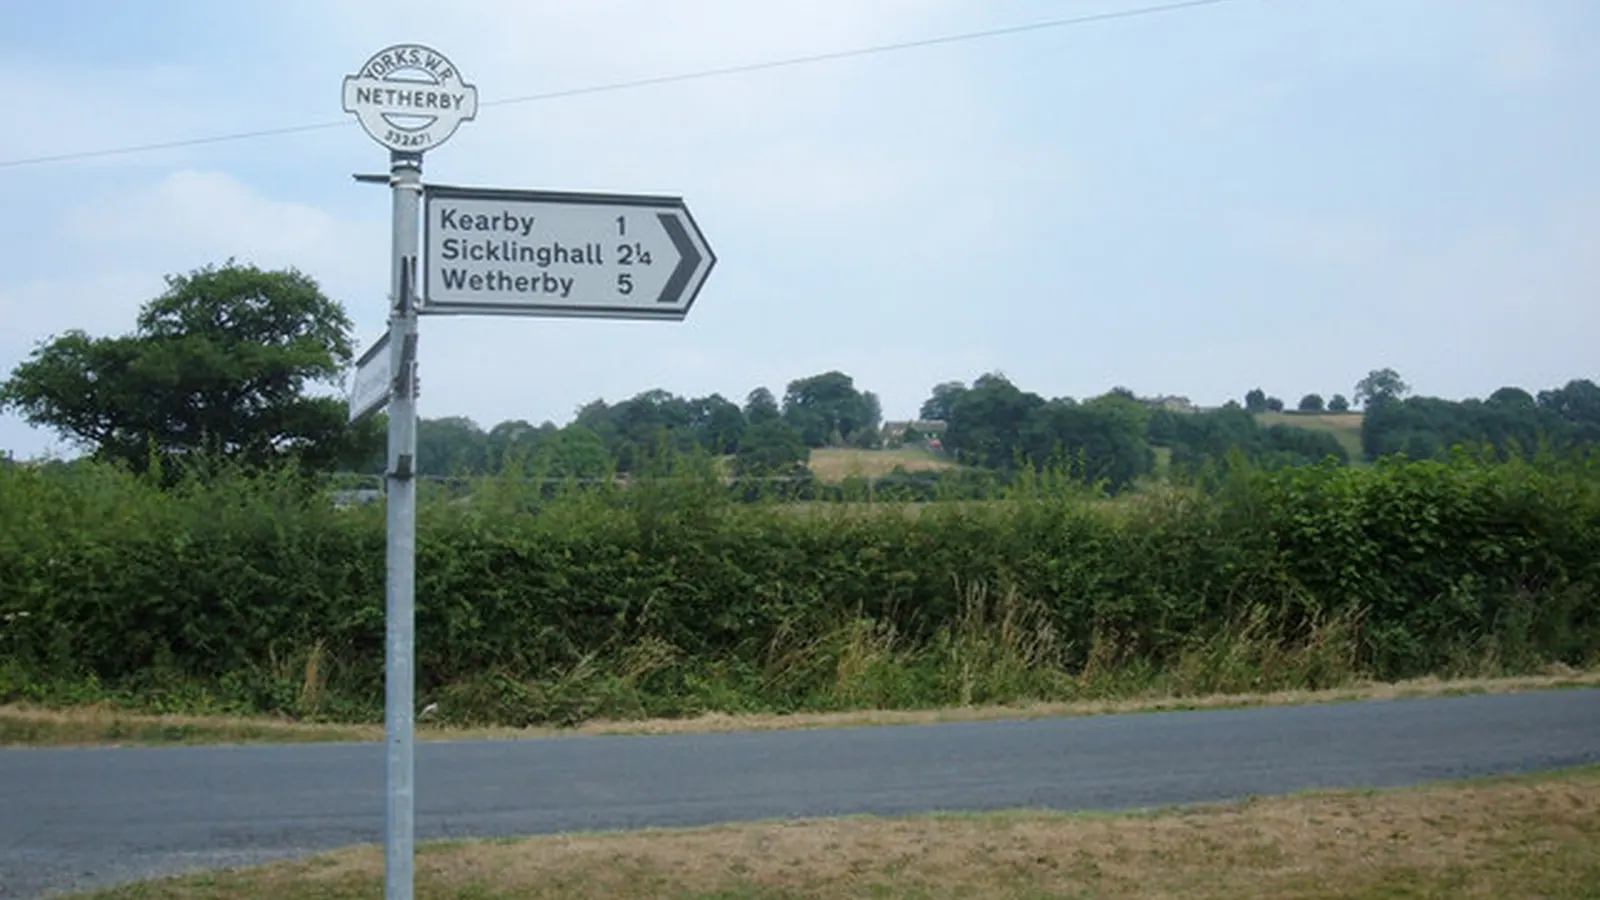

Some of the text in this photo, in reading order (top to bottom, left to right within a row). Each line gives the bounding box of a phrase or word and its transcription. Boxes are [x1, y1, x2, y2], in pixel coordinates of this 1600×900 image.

[356, 87, 465, 110] NETHERBY
[440, 209, 626, 236] Kearby 1
[441, 239, 604, 268] Sicklinghall
[441, 269, 634, 298] Wetherby 5
